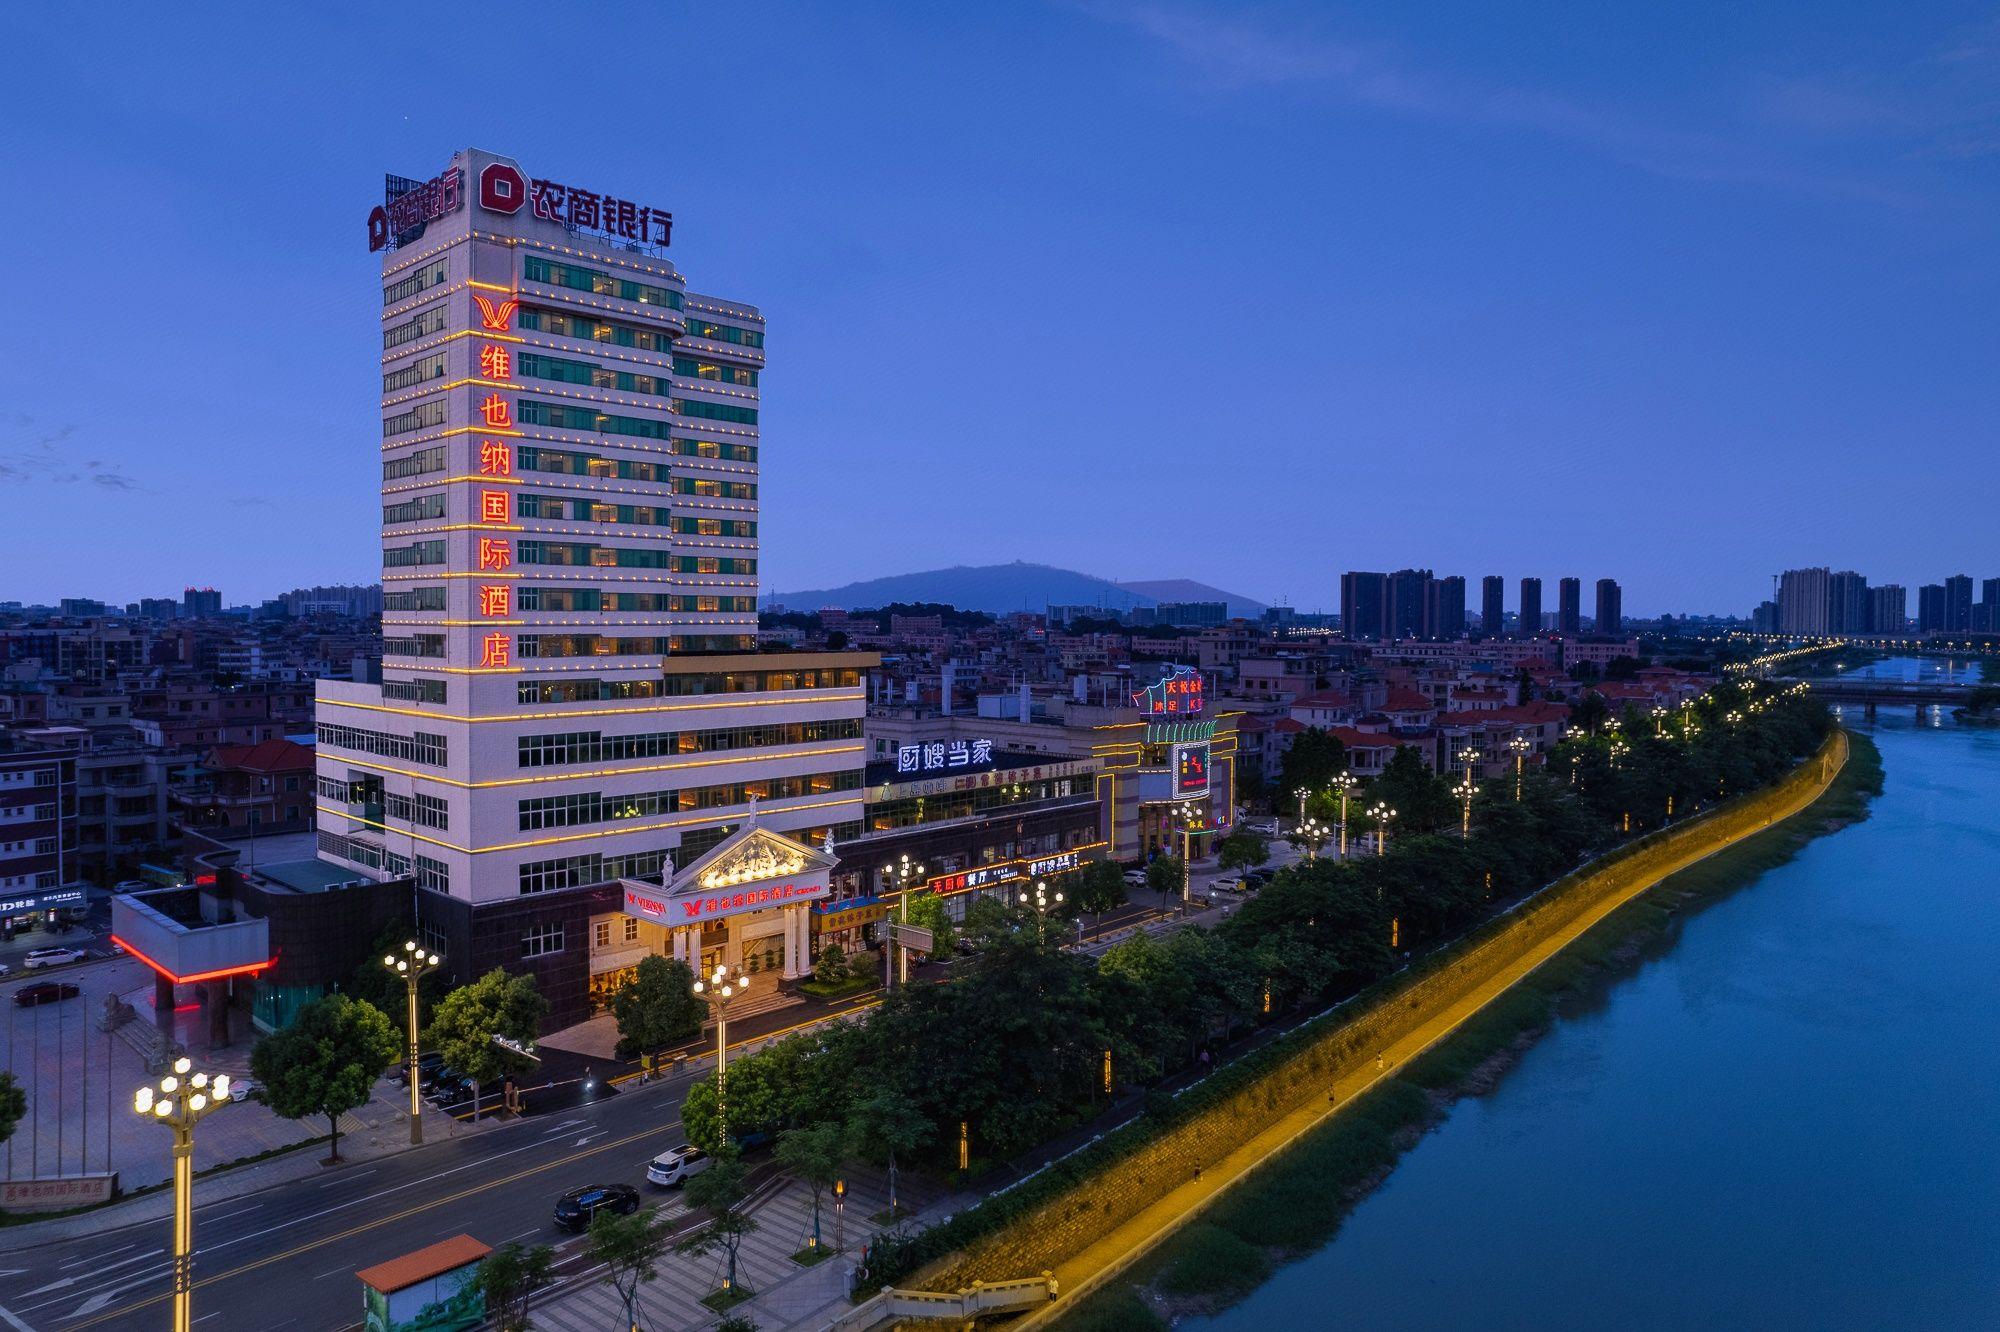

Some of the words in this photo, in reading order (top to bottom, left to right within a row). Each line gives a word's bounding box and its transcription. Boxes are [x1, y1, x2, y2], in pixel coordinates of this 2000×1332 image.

[530, 178, 673, 248] 农商银行
[480, 344, 512, 668] 维也纳国际酒店
[898, 739, 992, 773] 厨嫂当家
[933, 870, 987, 893] 无厨师餐厅
[637, 895, 667, 914] VIENNA
[706, 884, 794, 912] 维也纳国际酒店
